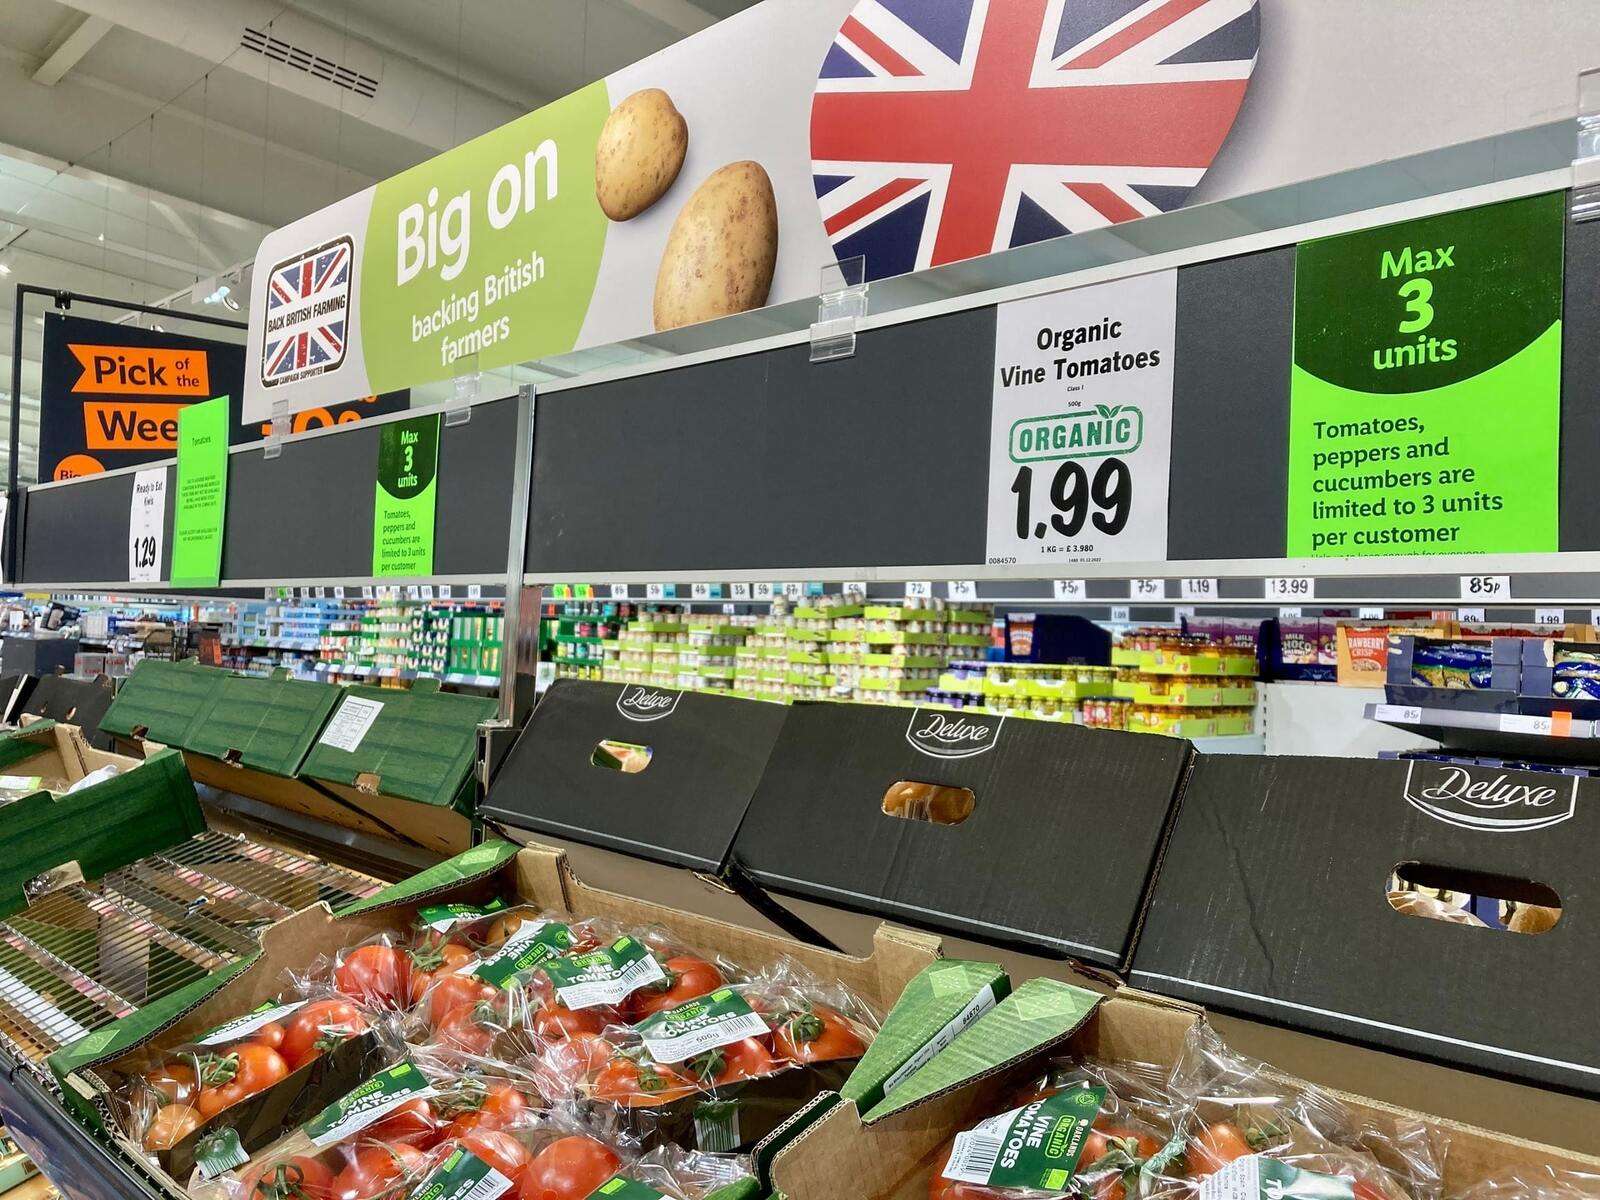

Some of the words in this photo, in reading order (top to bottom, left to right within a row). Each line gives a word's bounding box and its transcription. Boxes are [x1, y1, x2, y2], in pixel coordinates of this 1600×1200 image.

[398, 186, 470, 287] Big
[487, 138, 558, 230] on
[1381, 245, 1455, 279] Max
[412, 289, 479, 342] backing
[485, 250, 545, 306] British
[1398, 278, 1434, 333] 3
[268, 316, 285, 333] BACK
[286, 307, 311, 326] BRITISH
[313, 295, 345, 318] FARMING
[440, 314, 510, 366] farmers
[1037, 317, 1122, 351] Organic
[1374, 335, 1458, 370] units
[94, 356, 168, 386] Pick
[175, 358, 190, 370] of
[177, 375, 200, 388] the
[280, 372, 299, 385] CAMPAIGN
[300, 366, 323, 380] SUPPORTER
[1001, 365, 1046, 388] Vine
[1054, 350, 1161, 380] Tomatoes
[97, 410, 178, 441] Wee
[401, 430, 418, 445] Max
[1019, 418, 1131, 452] ORGANIC
[1313, 416, 1424, 439] Tomatoes,
[404, 445, 413, 472] 3
[1313, 445, 1400, 471] peppers
[1406, 437, 1449, 459] and
[136, 484, 149, 495] Ready
[155, 482, 163, 491] Eat
[398, 473, 418, 488] units
[1312, 470, 1432, 493] cucumbers
[1438, 468, 1475, 485] are
[1011, 457, 1132, 540] 1.99
[1313, 498, 1386, 519] limited
[1393, 499, 1416, 515] to
[1422, 495, 1435, 514] 3
[1442, 491, 1503, 513] units
[383, 523, 404, 535] peppers
[405, 521, 415, 530] and
[384, 510, 411, 520] Tomatoes,
[382, 535, 410, 545] cucumbers
[411, 536, 420, 544] are
[1073, 544, 1094, 552] 3.980
[1312, 530, 1347, 551] per
[1353, 526, 1460, 545] customer
[134, 536, 156, 569] 1.29
[382, 549, 400, 558] limited
[401, 548, 407, 557] to
[408, 548, 412, 556] 3
[412, 547, 426, 557] units
[382, 562, 390, 572] per
[391, 560, 416, 571] customer
[1061, 581, 1078, 594] 75p
[1189, 579, 1210, 593] 1.19
[1470, 577, 1500, 594] 85p
[623, 687, 672, 709] Deluxe
[1403, 709, 1419, 719] 85p
[916, 714, 989, 742] Deluxe
[1422, 766, 1556, 809] Deluxe
[507, 938, 535, 960] VINE
[517, 944, 546, 970] ORGANIC
[567, 960, 636, 983] TOMATOES
[582, 964, 613, 973] VINE
[696, 1032, 719, 1042] 500g
[327, 1088, 411, 1128] TOMATOES
[347, 1090, 384, 1109] VINE
[1001, 1098, 1048, 1169] TOMATOES
[1026, 1115, 1050, 1149] VINE
[1049, 1117, 1069, 1155] ORGANIC
[1066, 1127, 1084, 1157] OAKLANDS
